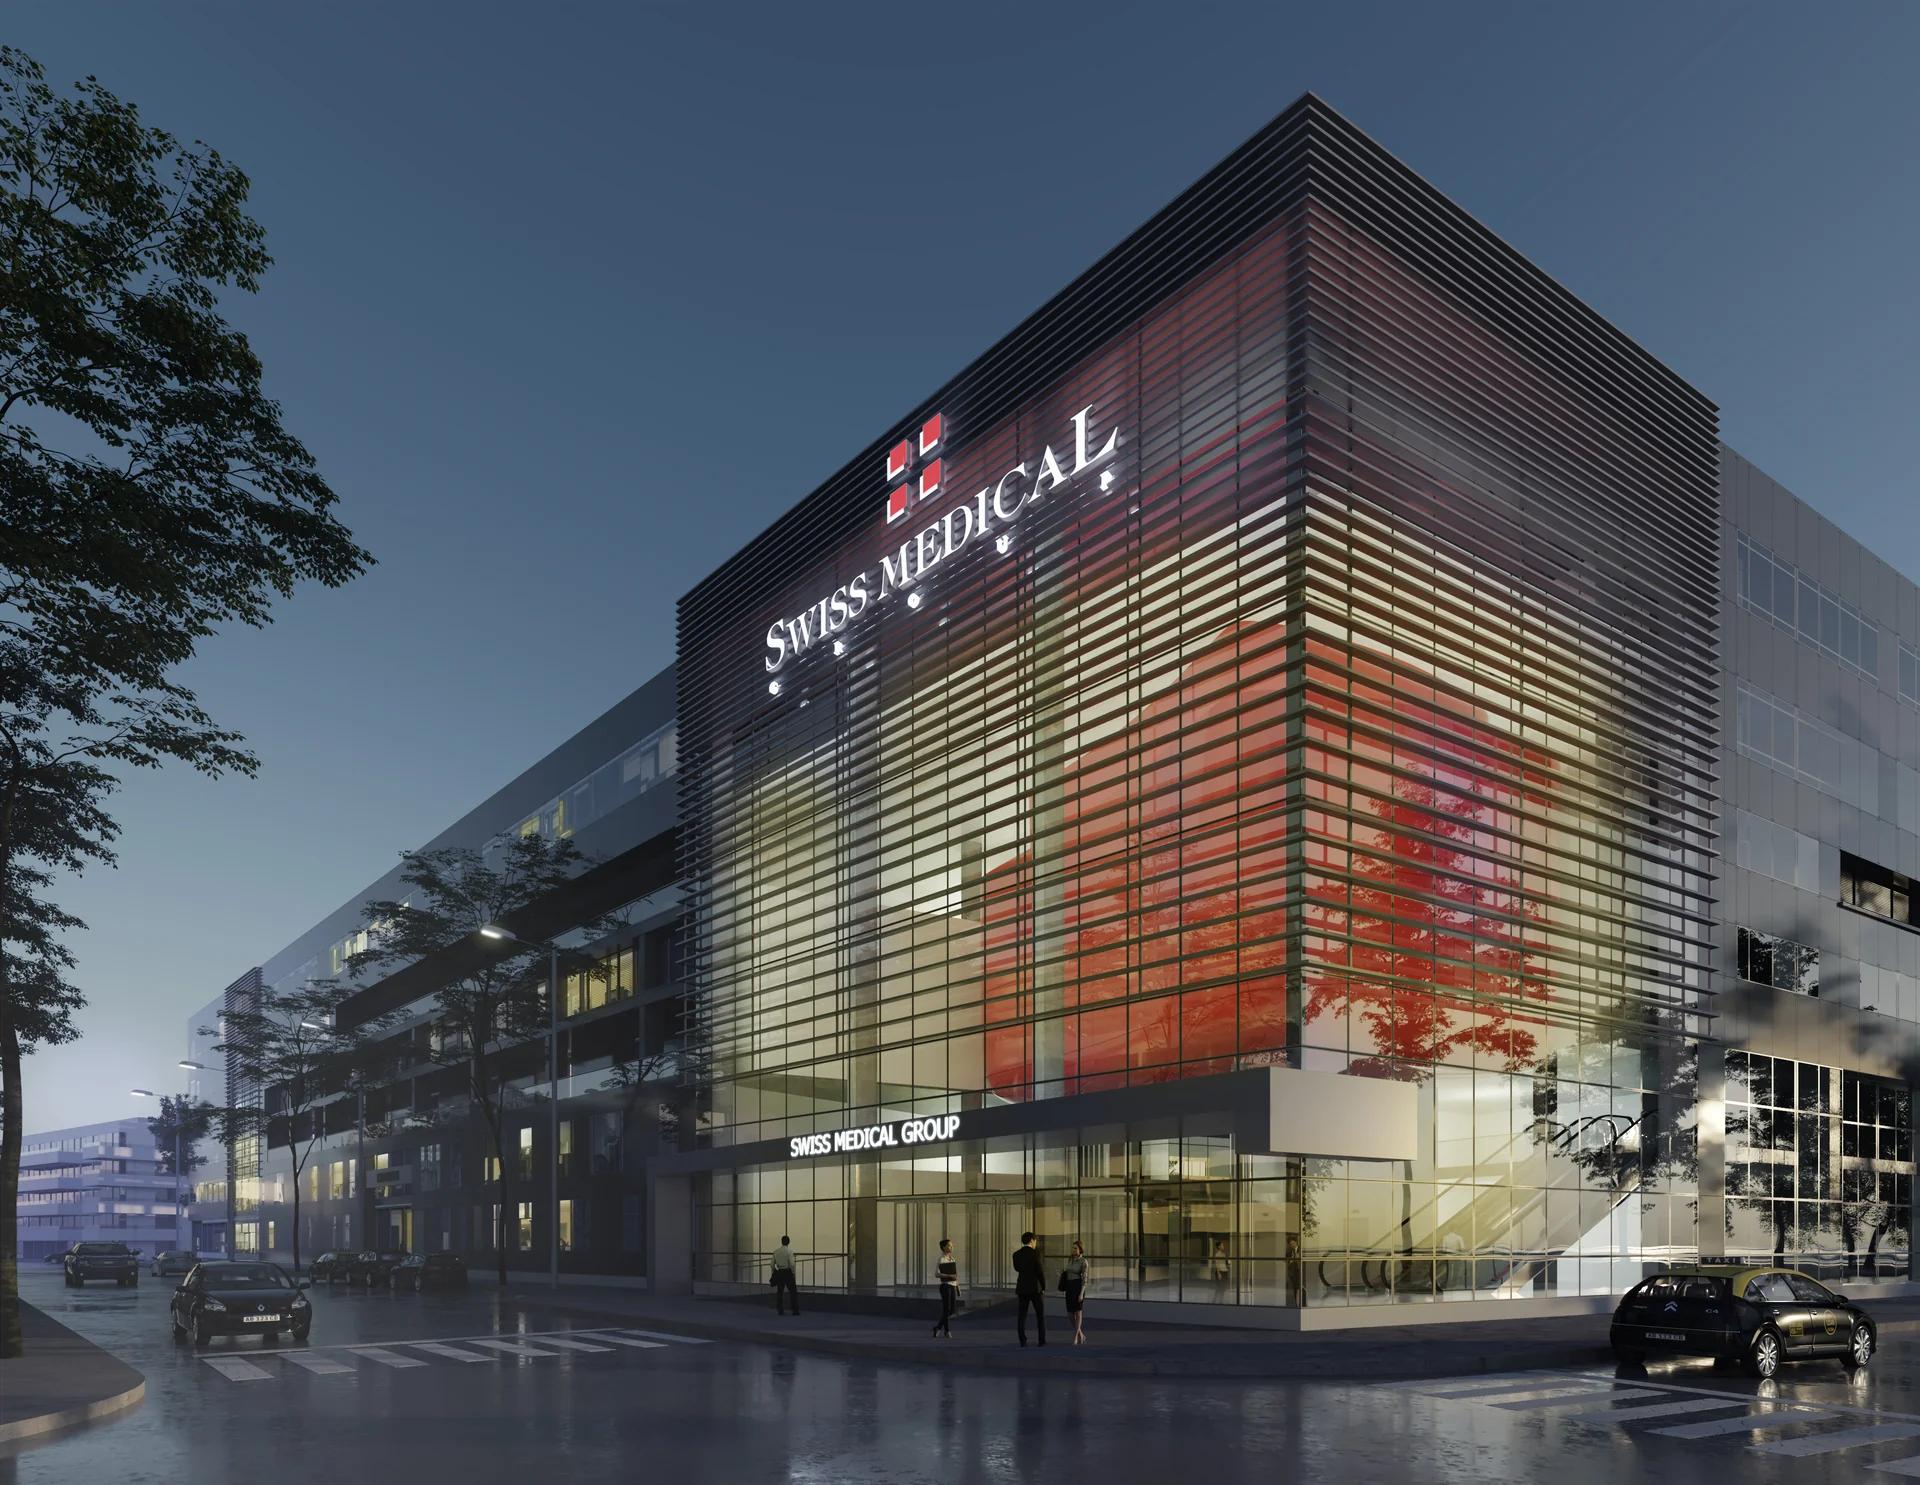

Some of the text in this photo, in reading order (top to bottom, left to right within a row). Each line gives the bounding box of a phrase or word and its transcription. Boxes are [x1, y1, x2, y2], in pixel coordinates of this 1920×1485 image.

[764, 403, 1119, 672] SWISS MEDICAL
[789, 1114, 961, 1158] SWISS MEDICAL GROUP
[1706, 1256, 1736, 1264] TAXI
